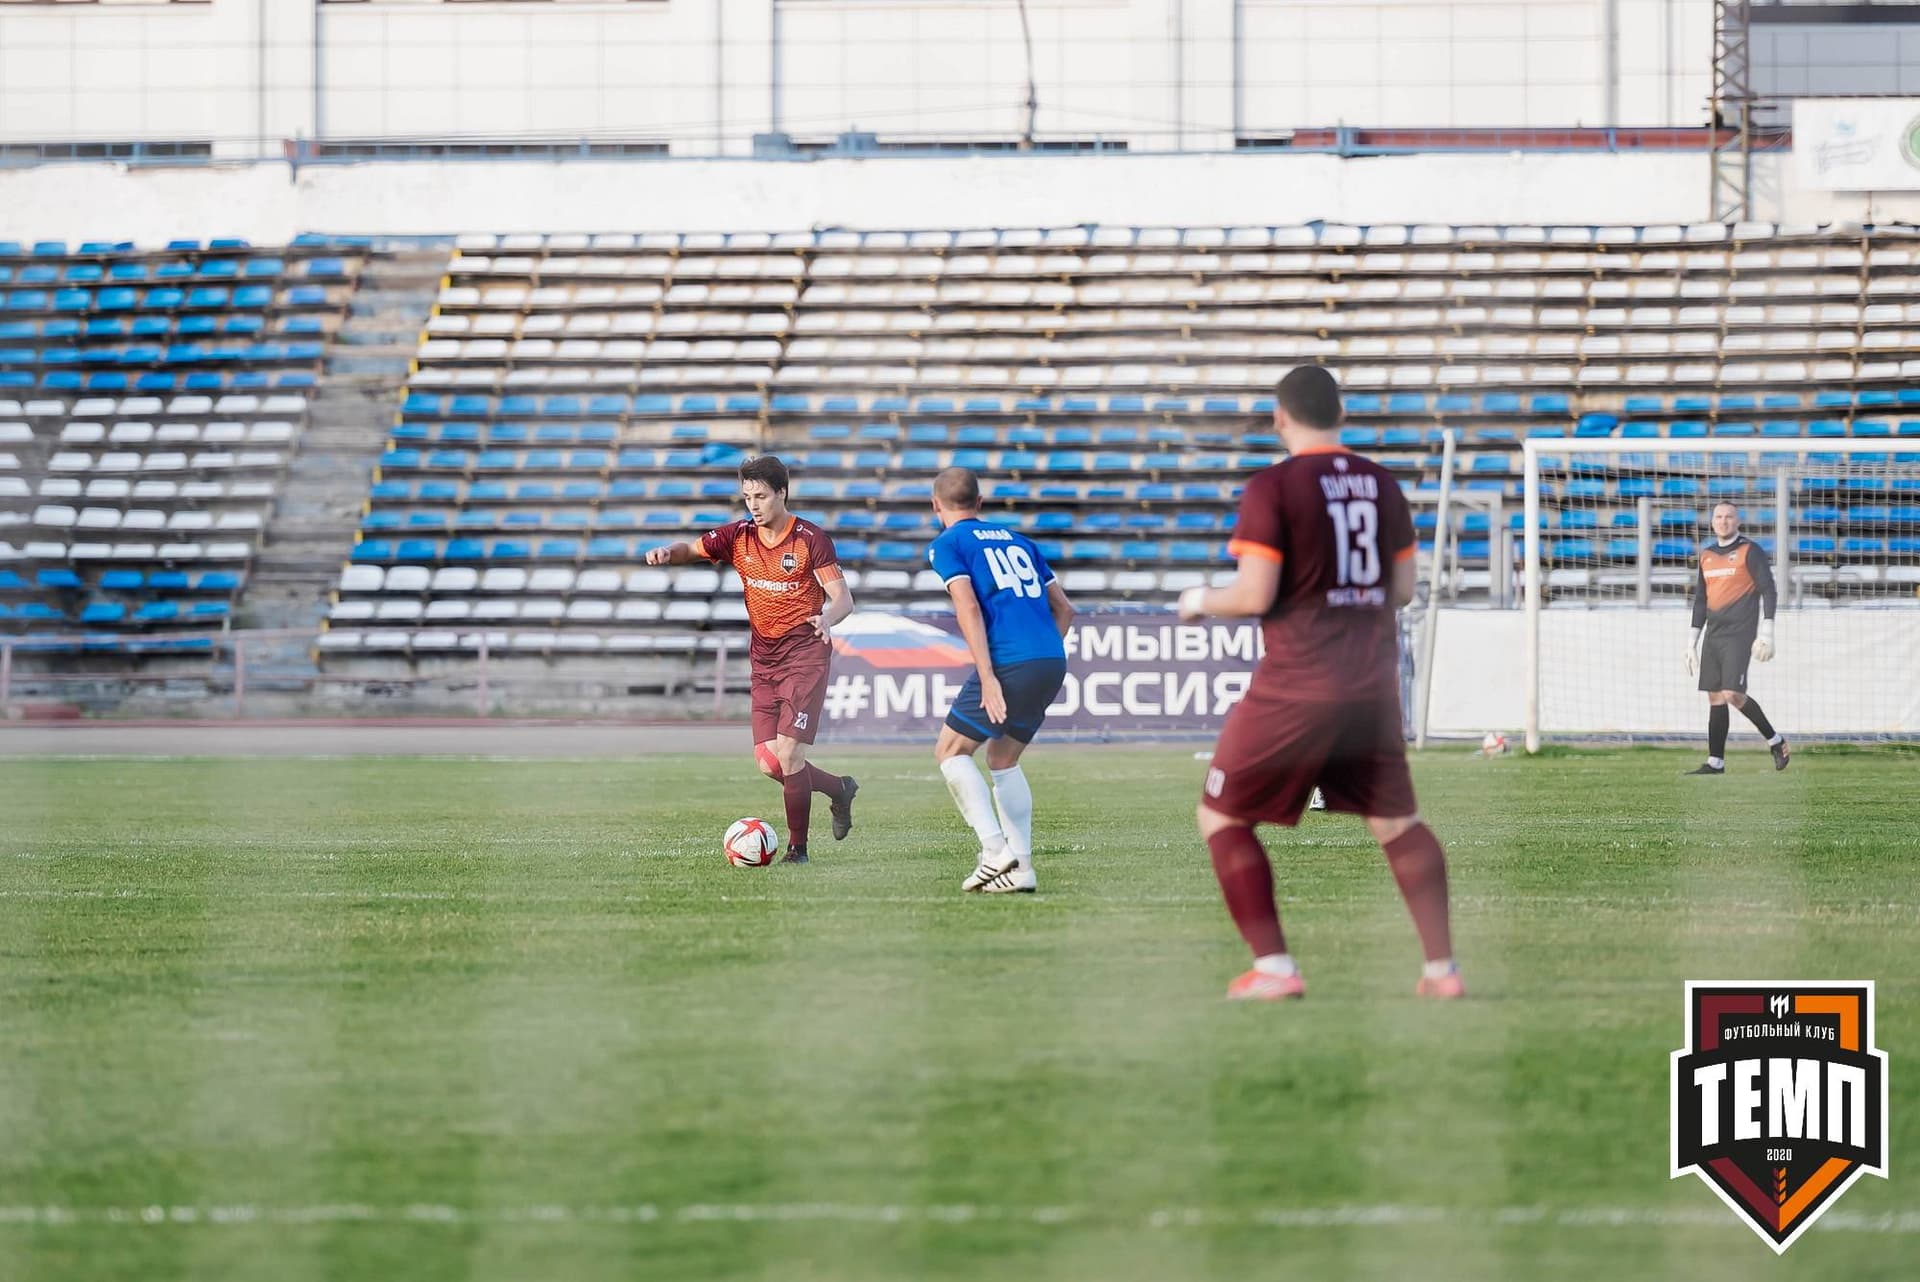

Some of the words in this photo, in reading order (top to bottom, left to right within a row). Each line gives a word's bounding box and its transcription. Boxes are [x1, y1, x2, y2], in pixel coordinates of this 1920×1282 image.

[1327, 500, 1381, 587] 13
[983, 545, 1042, 598] 49
[1064, 625, 1266, 661] МЫВМ
[794, 711, 809, 730] 23
